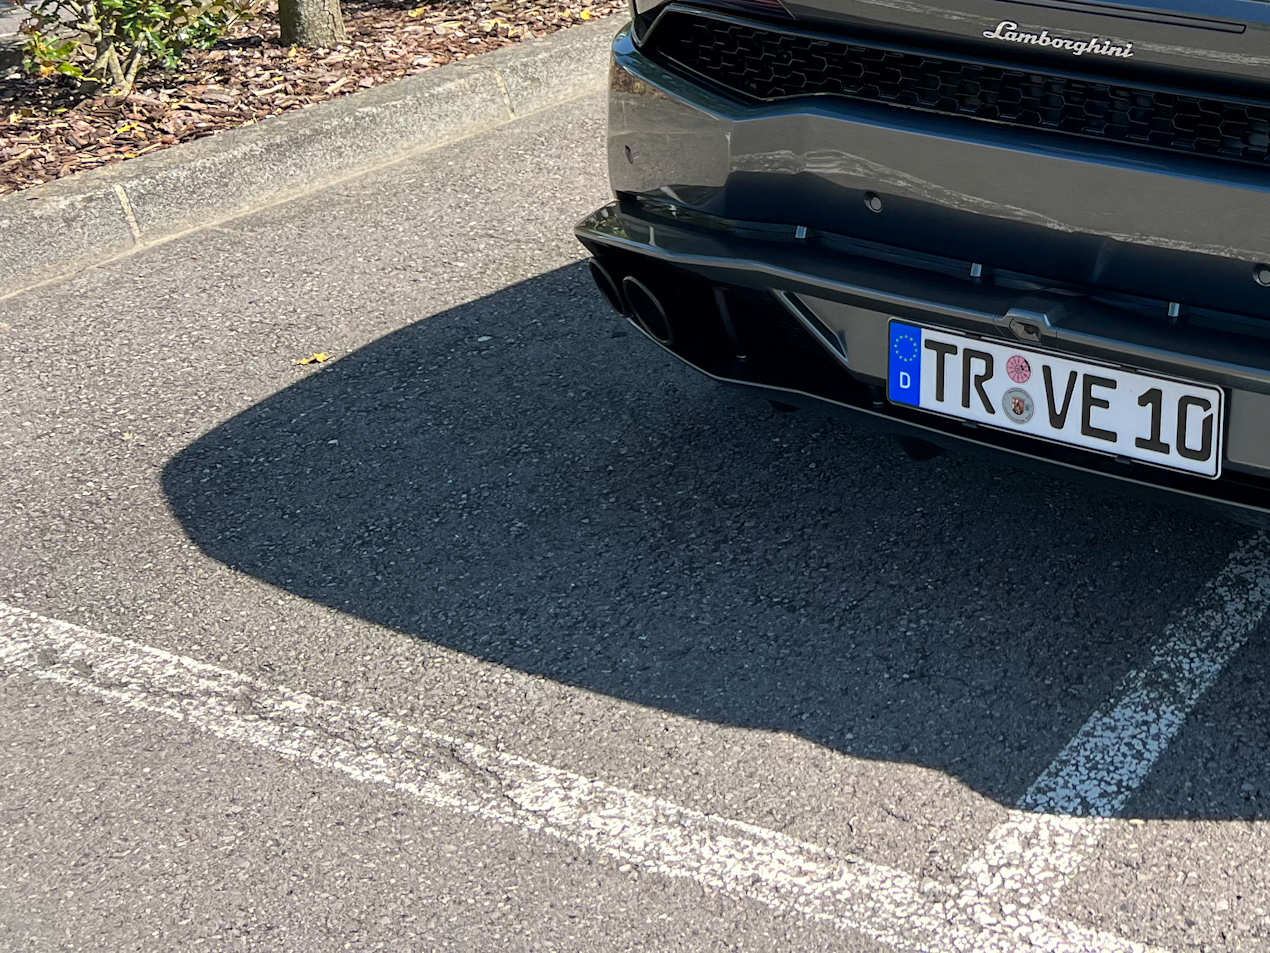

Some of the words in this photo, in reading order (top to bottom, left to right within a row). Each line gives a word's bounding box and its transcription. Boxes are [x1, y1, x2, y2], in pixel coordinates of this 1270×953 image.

[982, 19, 1134, 59] Lamborghini
[899, 371, 911, 390] D
[924, 338, 996, 416] TR
[1042, 364, 1118, 443] VE
[1134, 388, 1214, 462] 10
